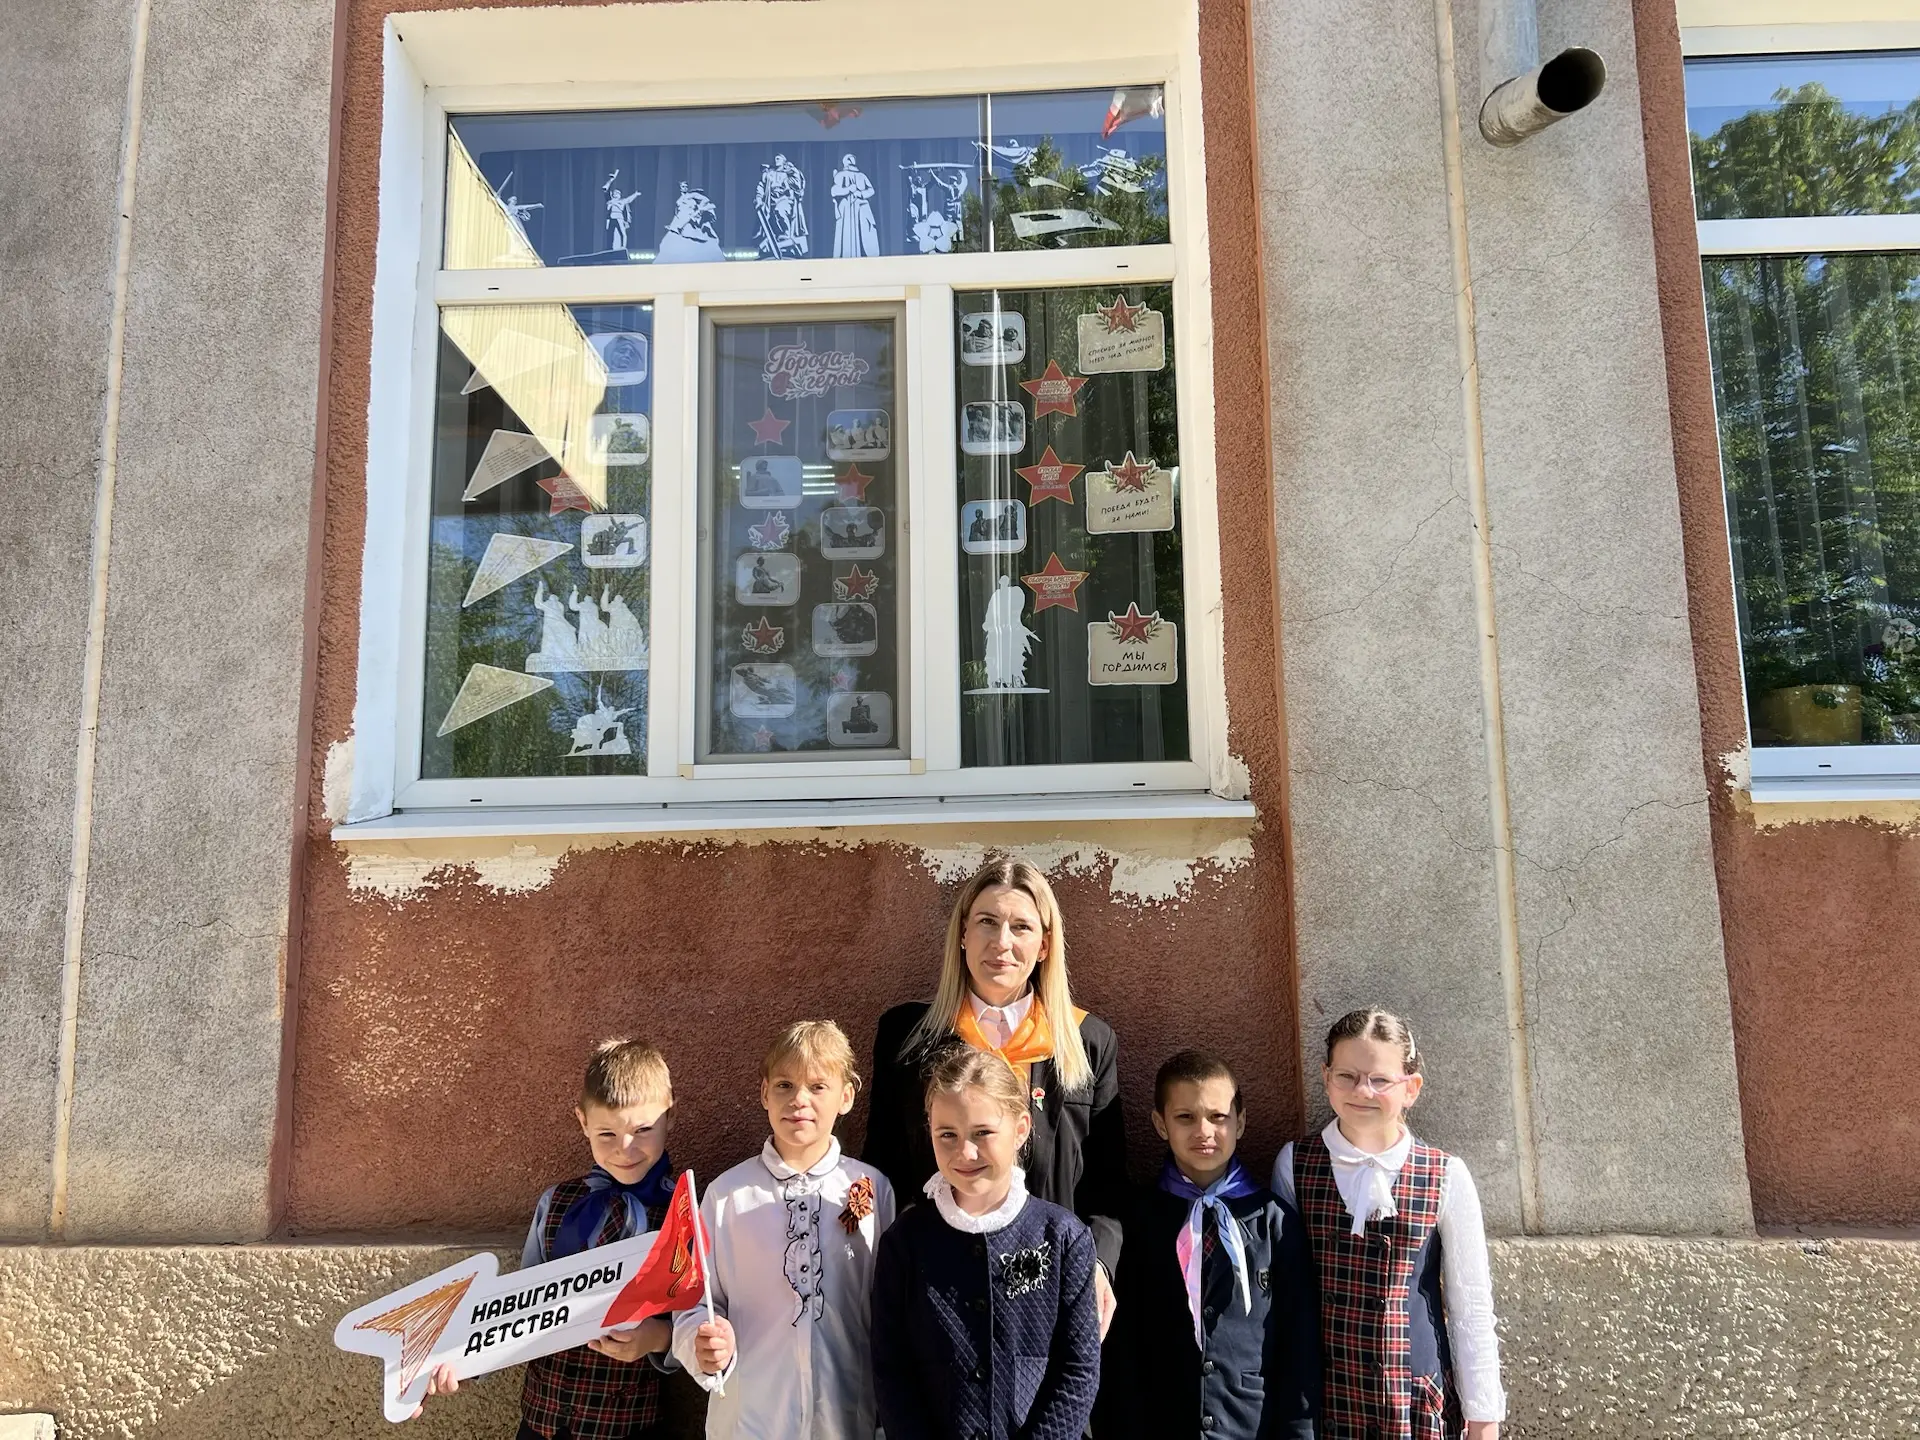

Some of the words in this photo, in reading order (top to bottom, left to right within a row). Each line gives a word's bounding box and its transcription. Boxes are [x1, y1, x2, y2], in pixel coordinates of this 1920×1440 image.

[1088, 345, 1115, 356] СПАСИБО
[1129, 335, 1154, 345] МИРНОЕ
[1088, 356, 1105, 364] НЕБО
[1101, 502, 1131, 515] ПОБЕДА
[1135, 494, 1160, 507] БУДЕТ
[1111, 515, 1121, 523] ЗА
[1125, 509, 1150, 520] НАМИ!
[1122, 651, 1145, 661] МЫ
[1102, 662, 1167, 673] ГОРДИМСЯ
[470, 1262, 623, 1325] НАВИГАТОРЫ
[463, 1305, 570, 1357] ДЕТСТВА
